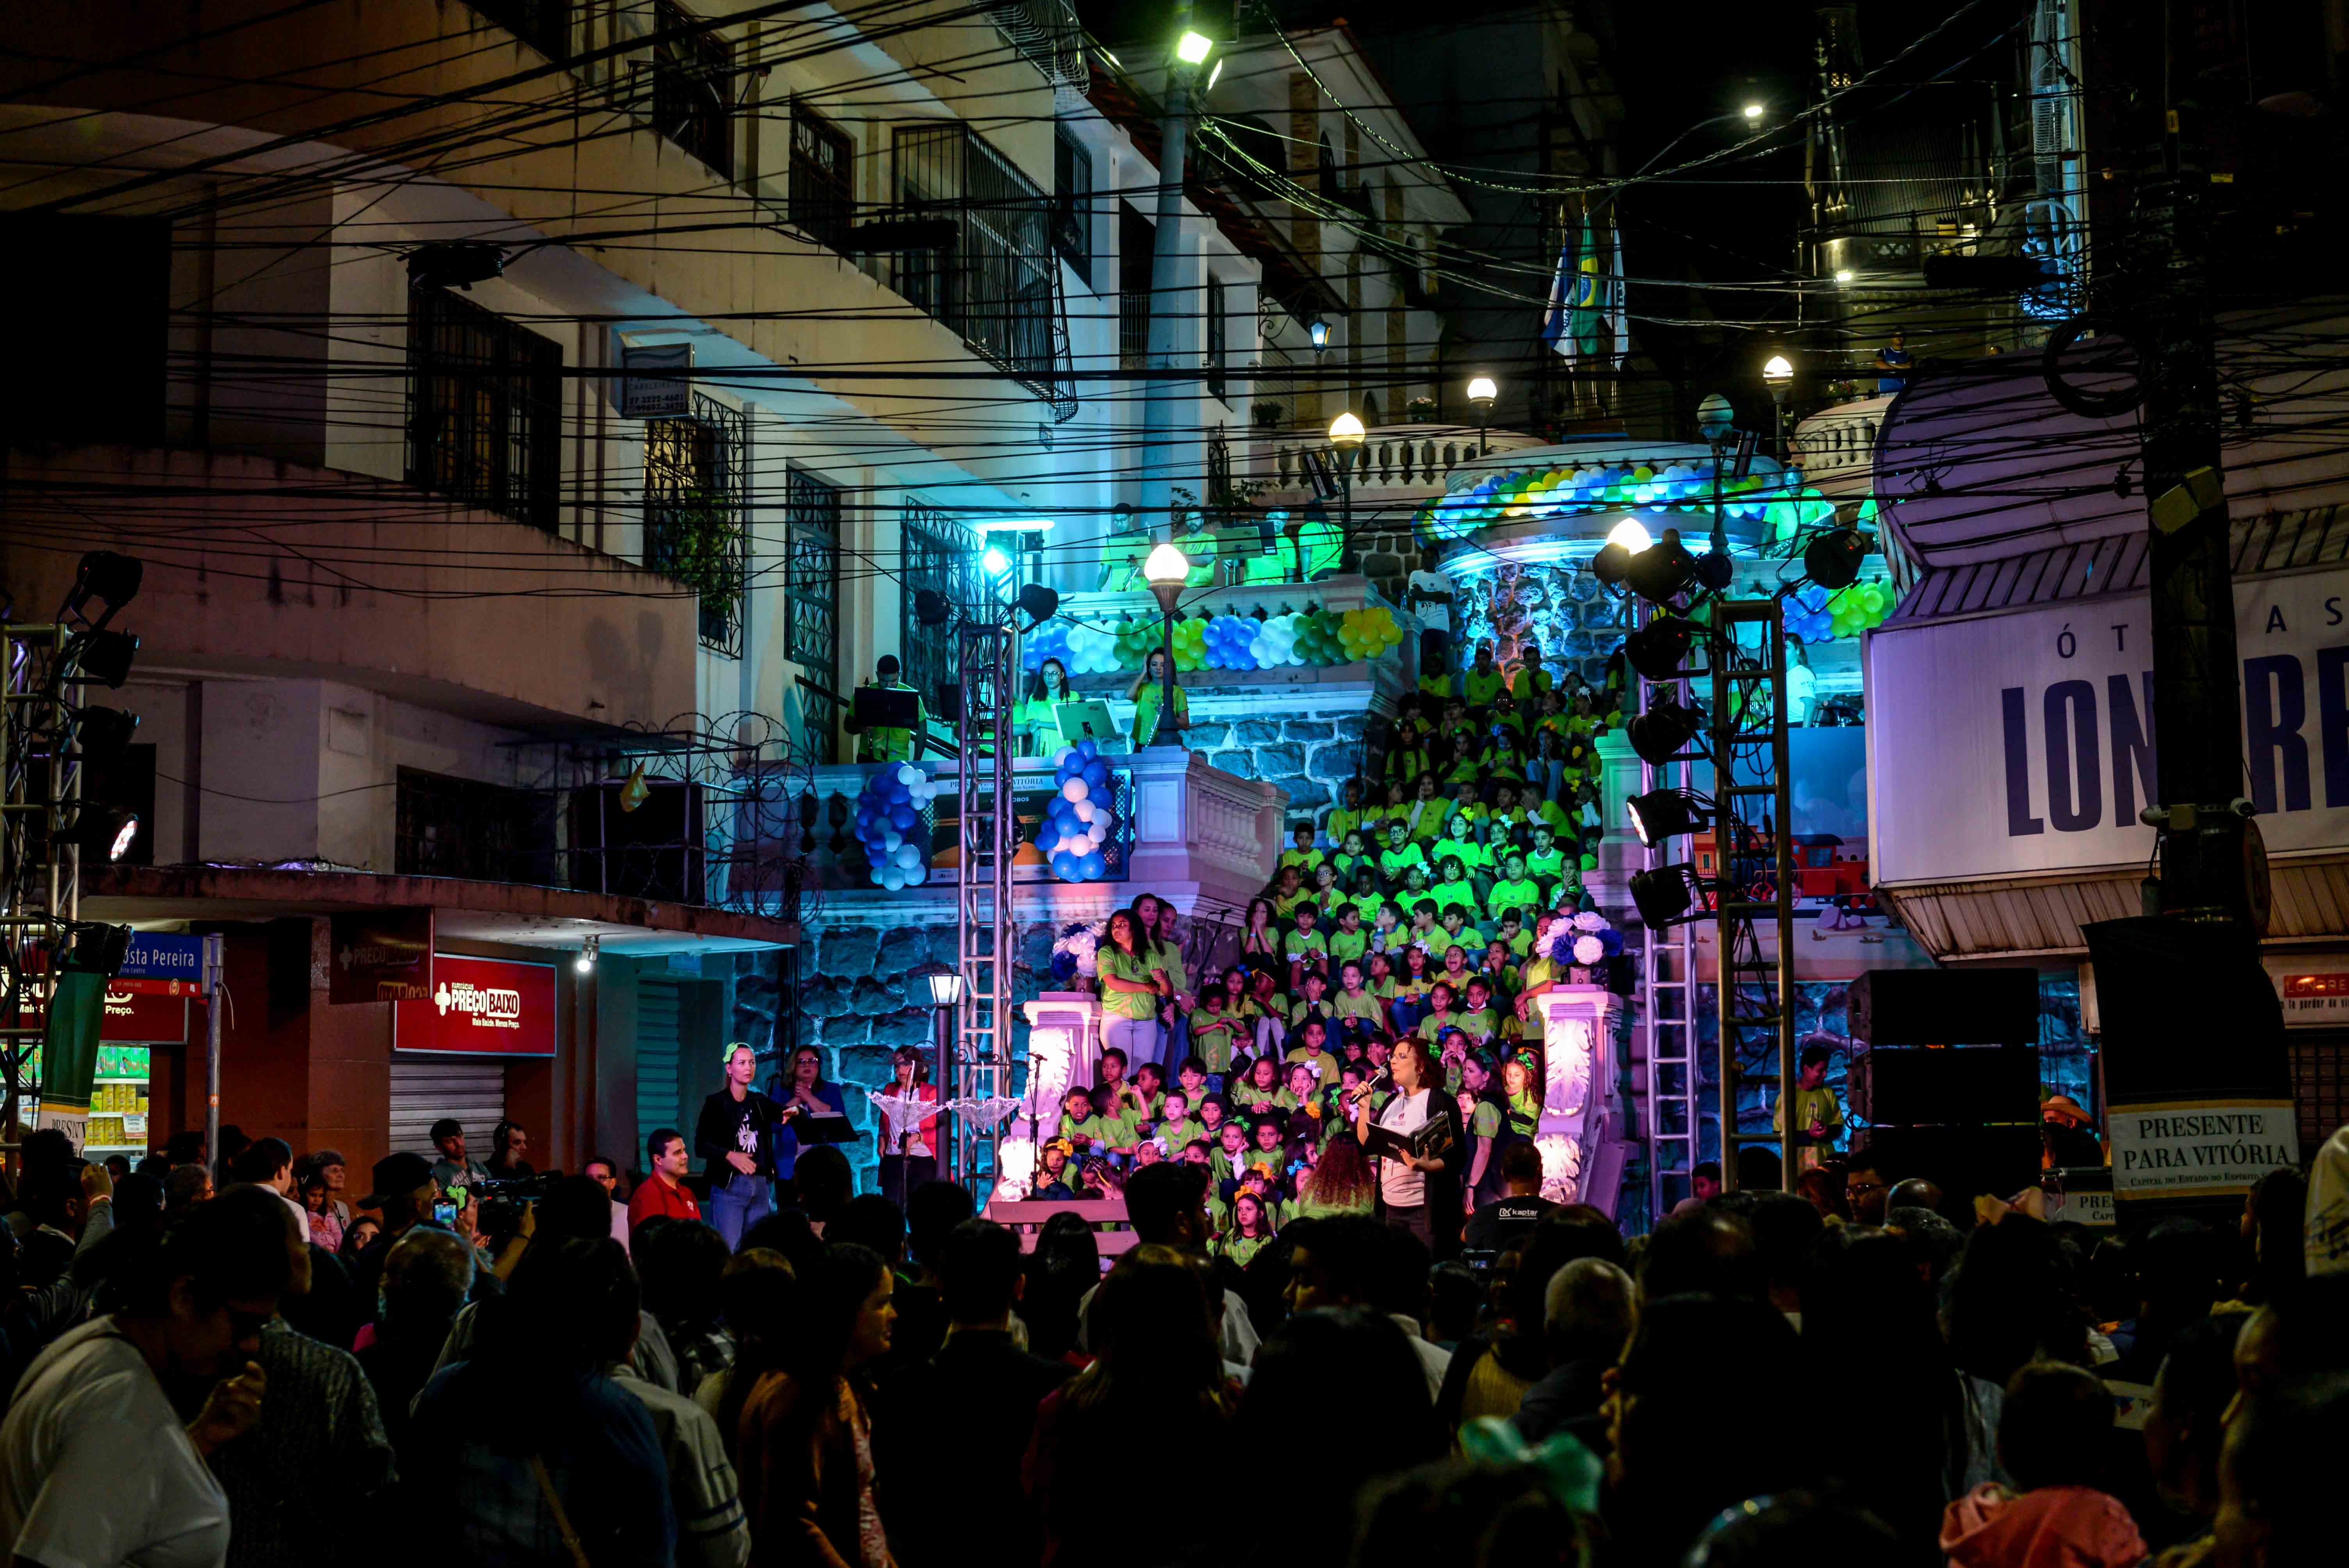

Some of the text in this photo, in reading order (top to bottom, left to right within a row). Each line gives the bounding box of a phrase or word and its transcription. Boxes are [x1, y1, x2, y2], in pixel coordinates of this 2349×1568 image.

[2057, 597, 2343, 659] ÓTAS
[2001, 645, 2349, 836] LONRE
[123, 948, 194, 967] osta Pereira
[105, 1005, 134, 1016] Preço.
[451, 989, 487, 1016] PREÇO
[489, 993, 518, 1014] BAIXO
[472, 1017, 481, 1026] Mais
[2139, 1115, 2263, 1139] PRESENTE
[2123, 1139, 2289, 1170] PARA VITÓRIA
